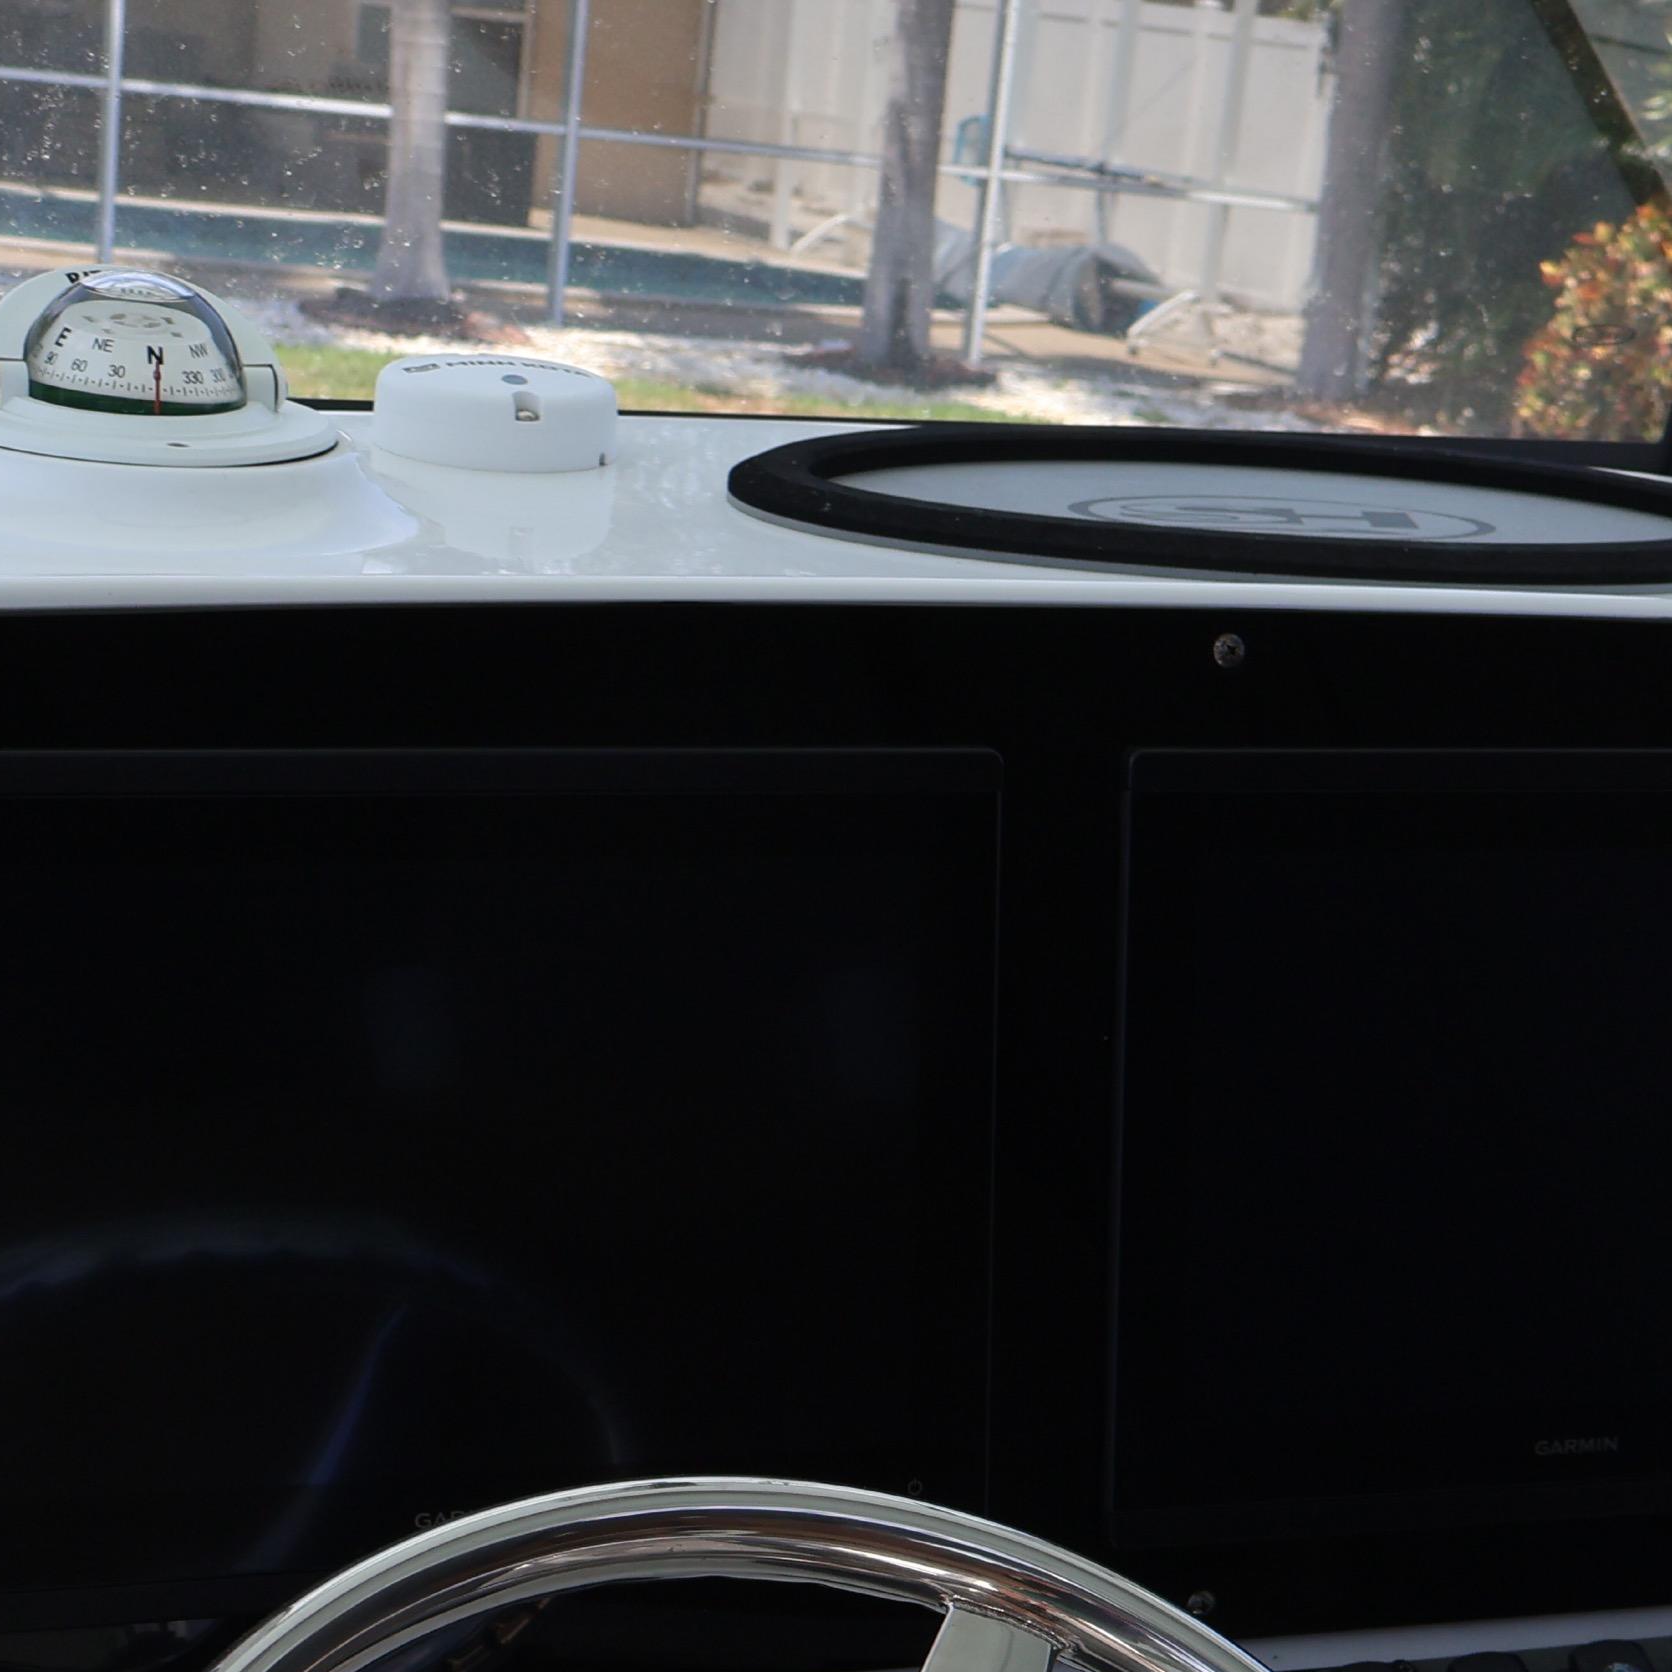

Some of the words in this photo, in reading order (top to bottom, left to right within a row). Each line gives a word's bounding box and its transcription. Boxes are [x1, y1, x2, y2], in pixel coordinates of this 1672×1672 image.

[55, 327, 72, 347] E
[92, 338, 114, 353] NE
[147, 346, 164, 365] N
[189, 343, 209, 358] NW
[70, 358, 88, 372] 60
[108, 364, 125, 378] 30
[182, 370, 204, 383] 330
[1534, 1436, 1620, 1457] GARMIN
